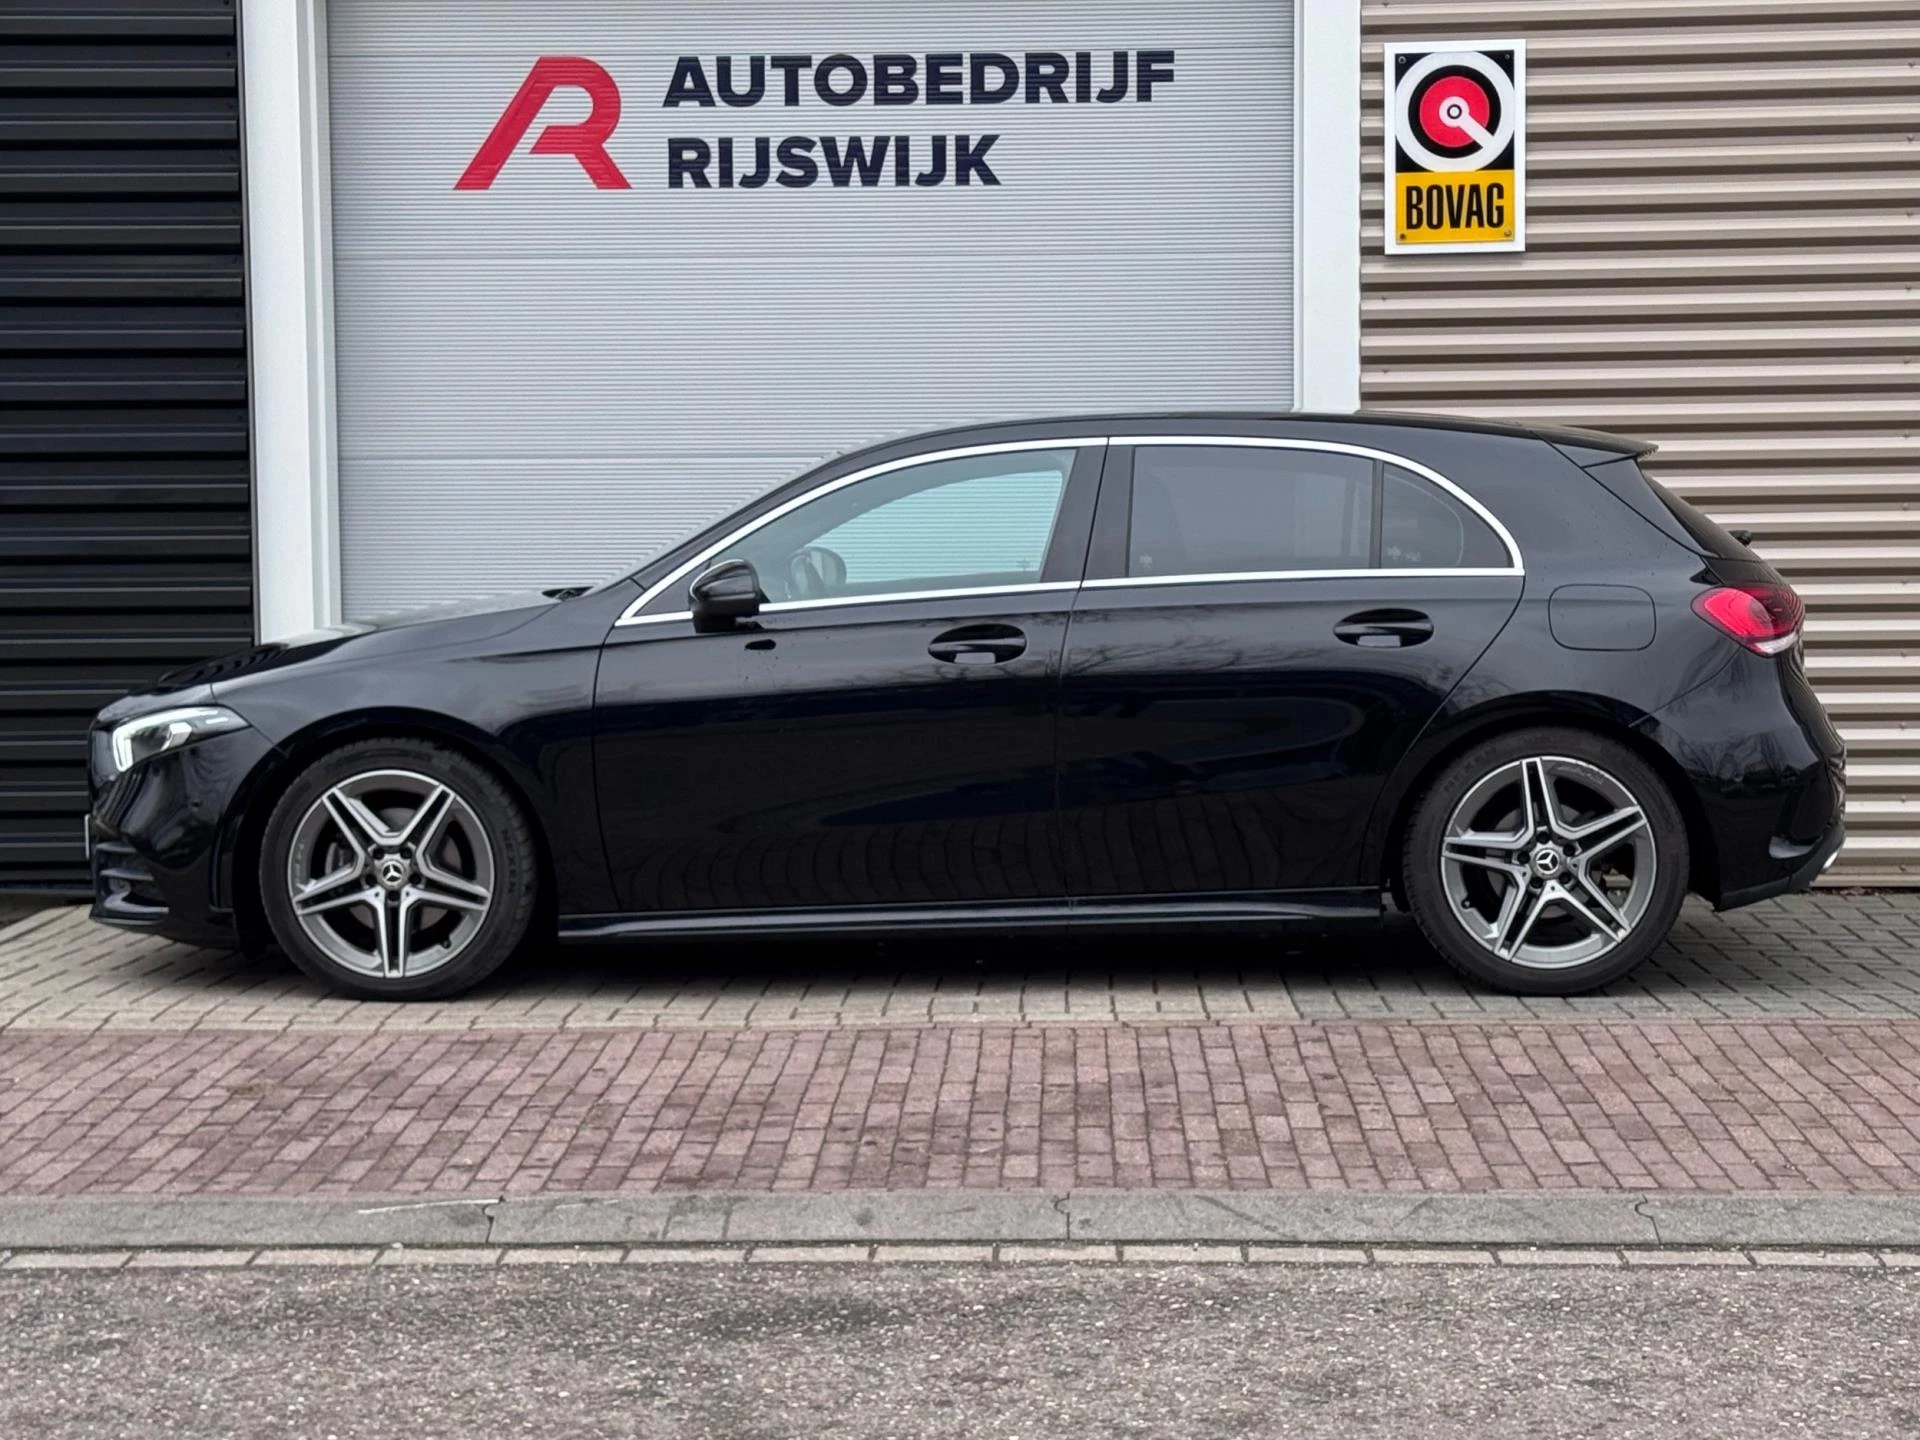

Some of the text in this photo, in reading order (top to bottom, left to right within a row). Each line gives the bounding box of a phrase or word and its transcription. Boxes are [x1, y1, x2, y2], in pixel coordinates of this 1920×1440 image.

[662, 50, 1175, 107] AUTOBEDRIJF
[667, 134, 1001, 189] RIJSWIJK
[1405, 182, 1505, 230] BOVAG
